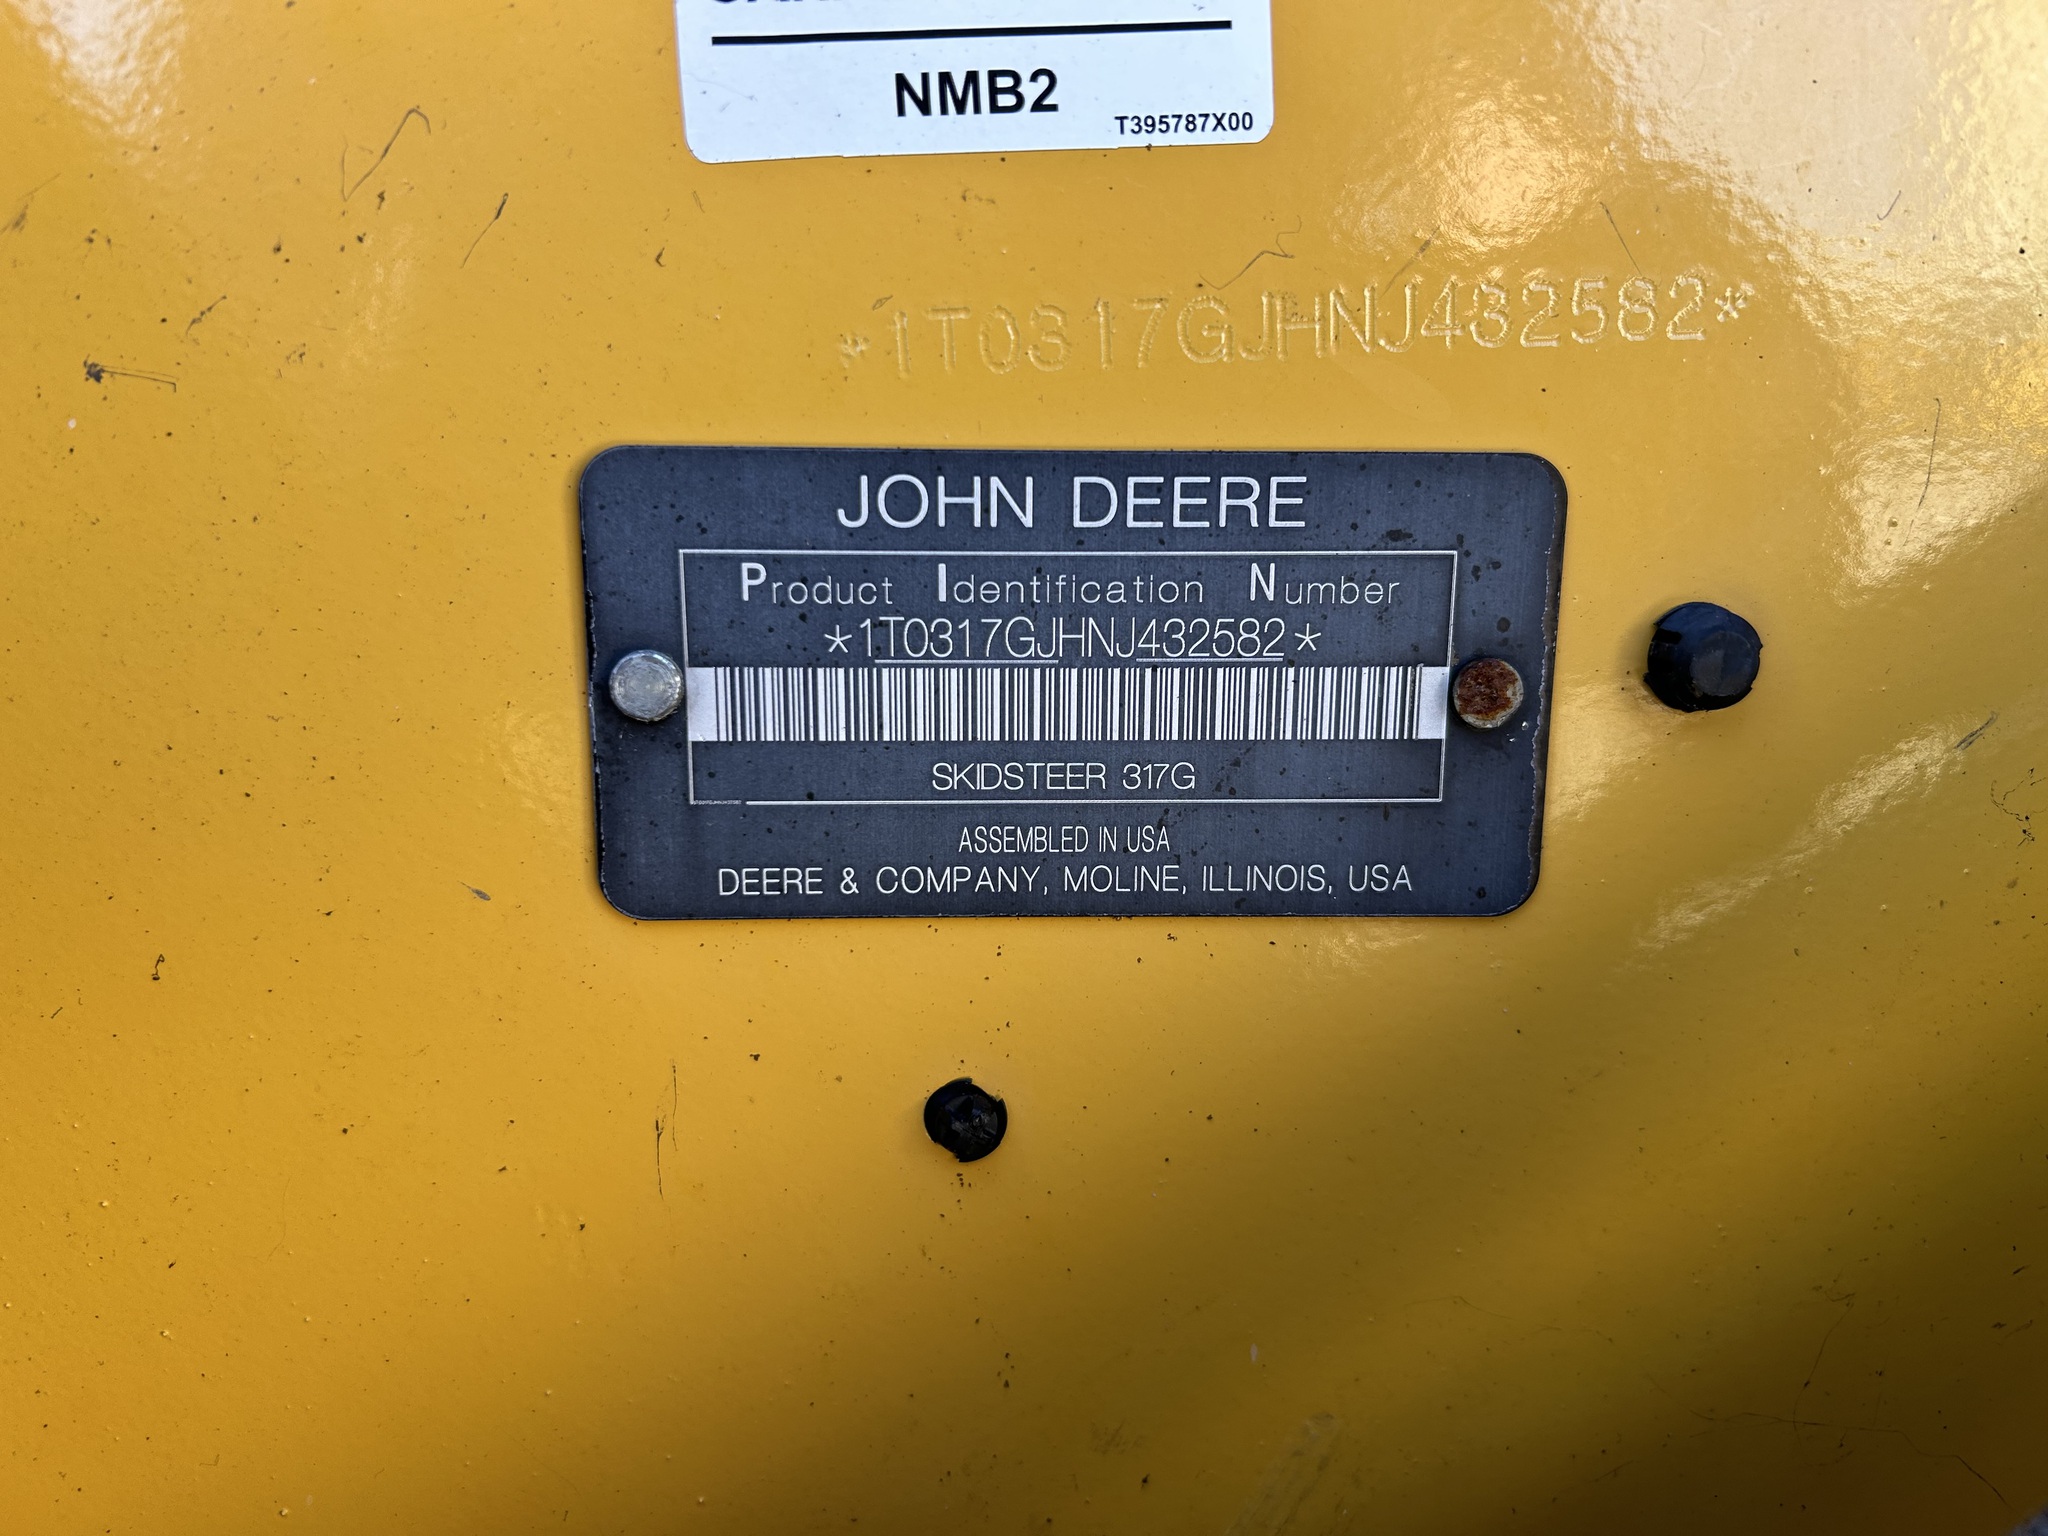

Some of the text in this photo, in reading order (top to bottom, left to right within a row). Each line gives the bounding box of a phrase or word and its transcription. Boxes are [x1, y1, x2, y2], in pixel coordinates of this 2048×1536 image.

[894, 68, 1059, 118] NMB2
[1114, 111, 1254, 136] T395787X00
[837, 473, 1307, 529] JOHN DEERE
[741, 562, 1400, 605] Product Identification Number
[932, 760, 1196, 791] SKIDSTEER 317G
[958, 824, 1171, 854] ASSEMBLED IN USA
[718, 863, 1413, 898] DEERE & COMPANY, MOLINE, ILLINOIS, USA
